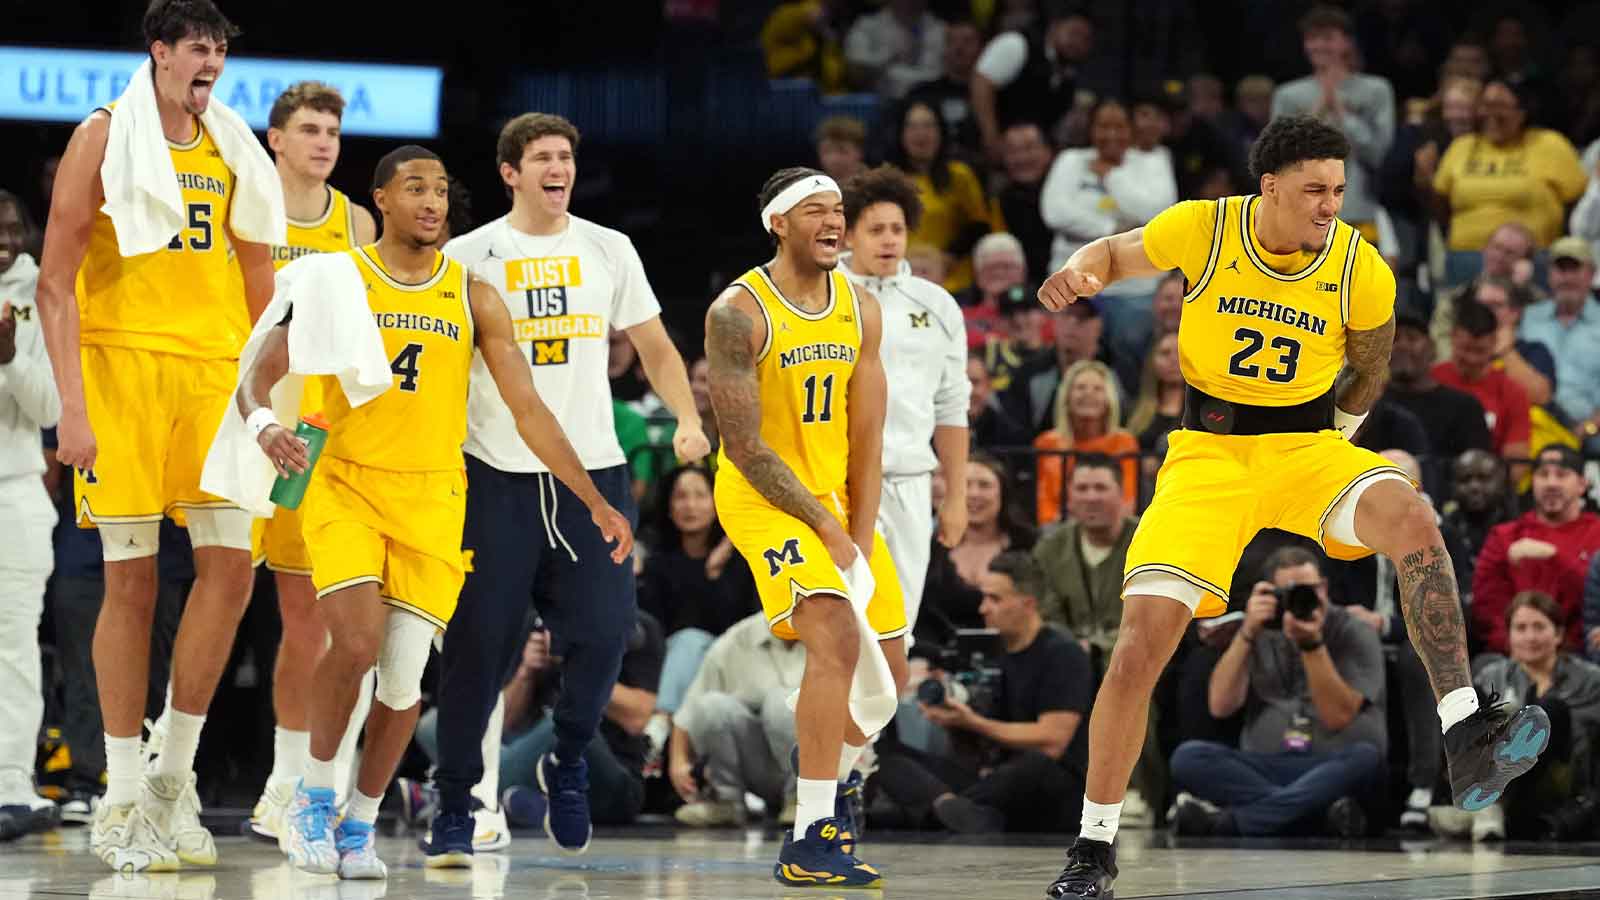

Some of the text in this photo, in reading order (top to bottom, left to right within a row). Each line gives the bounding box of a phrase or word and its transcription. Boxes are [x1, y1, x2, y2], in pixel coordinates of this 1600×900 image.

[19, 66, 373, 116] ULTR ARA
[515, 259, 571, 289] JUST
[531, 287, 563, 317] US
[1216, 296, 1327, 336] MICHIGAN
[373, 313, 460, 341] ICHIGAN
[513, 318, 600, 340] ICHIGAN
[908, 311, 931, 328] M
[535, 340, 566, 364] M
[780, 343, 856, 369] MICHIGAN
[1228, 327, 1301, 383] 23
[391, 343, 423, 392] 4
[802, 374, 834, 423] 11
[763, 538, 805, 577] M
